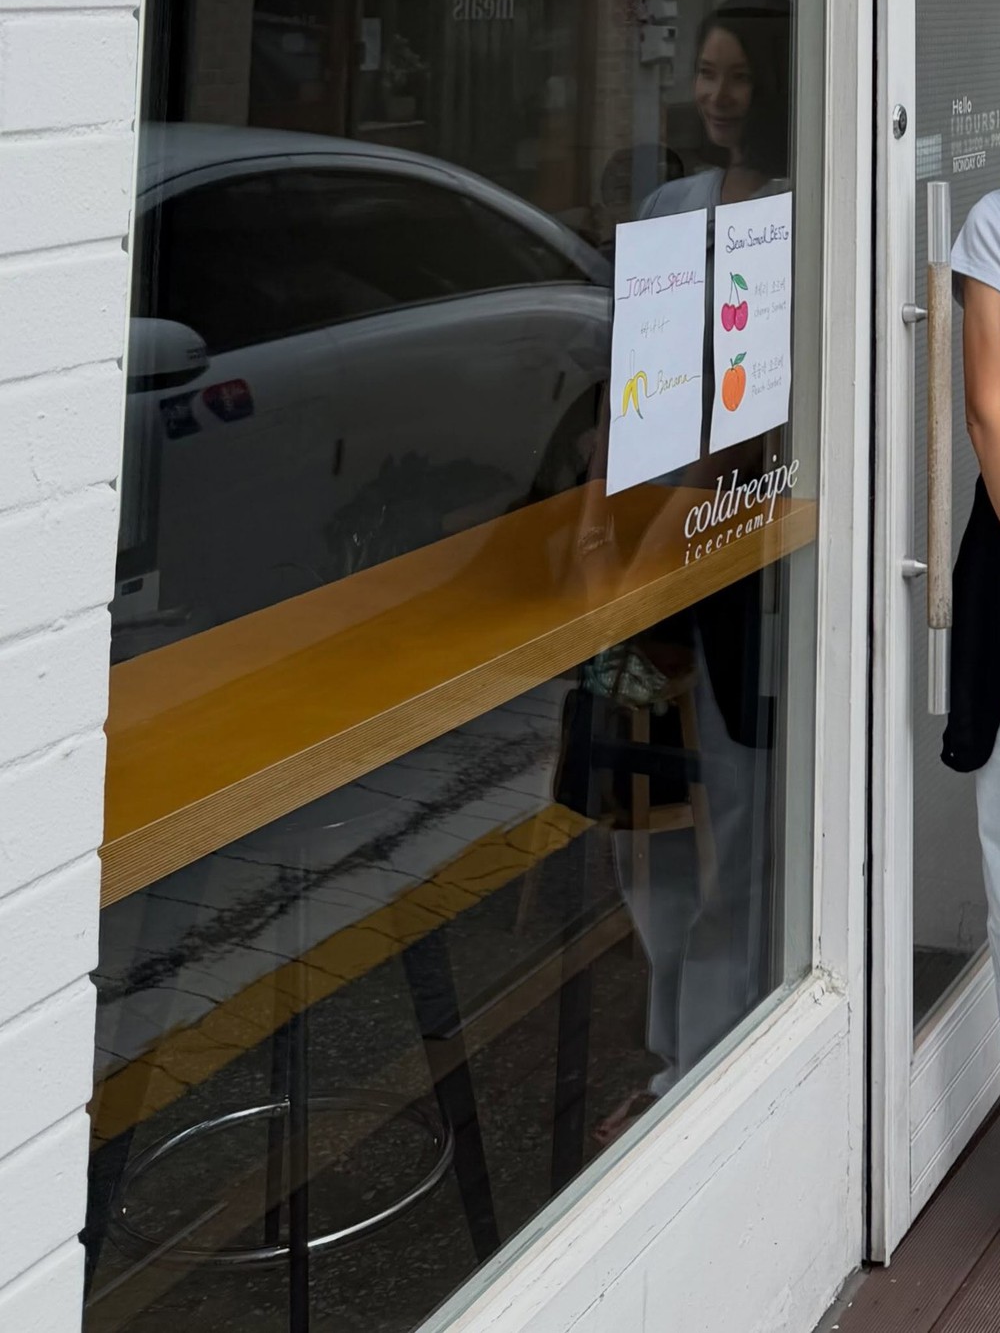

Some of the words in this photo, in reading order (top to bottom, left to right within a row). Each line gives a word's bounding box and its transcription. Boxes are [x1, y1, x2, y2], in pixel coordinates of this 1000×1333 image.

[952, 96, 972, 115] Hello
[952, 156, 975, 173] MONDAY
[976, 154, 986, 168] OFF
[656, 369, 689, 395] Banana
[684, 455, 799, 540] coldrecipe
[684, 513, 764, 565] icecream
